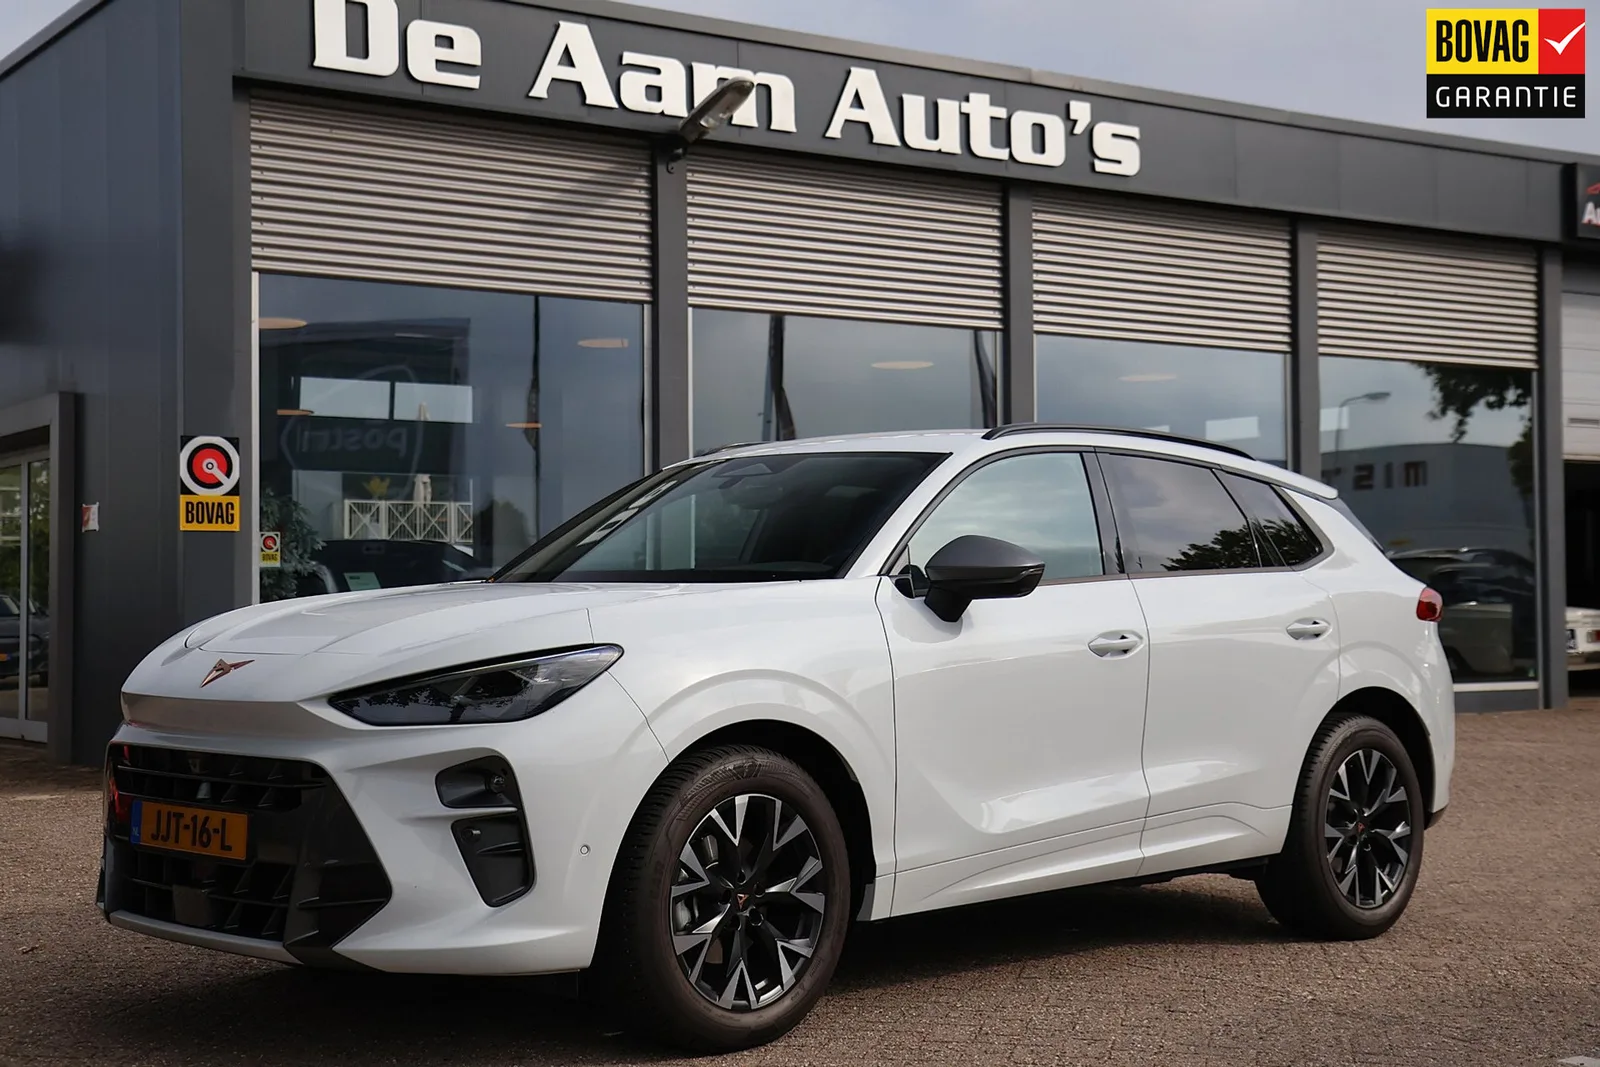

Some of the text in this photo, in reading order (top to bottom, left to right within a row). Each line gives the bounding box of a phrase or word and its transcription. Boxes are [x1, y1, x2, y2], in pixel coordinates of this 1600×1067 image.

[313, 0, 1141, 177] De Aam Auto's
[185, 501, 235, 525] BOVAG
[261, 553, 279, 562] BOVAG
[150, 809, 233, 852] JJT-16-L
